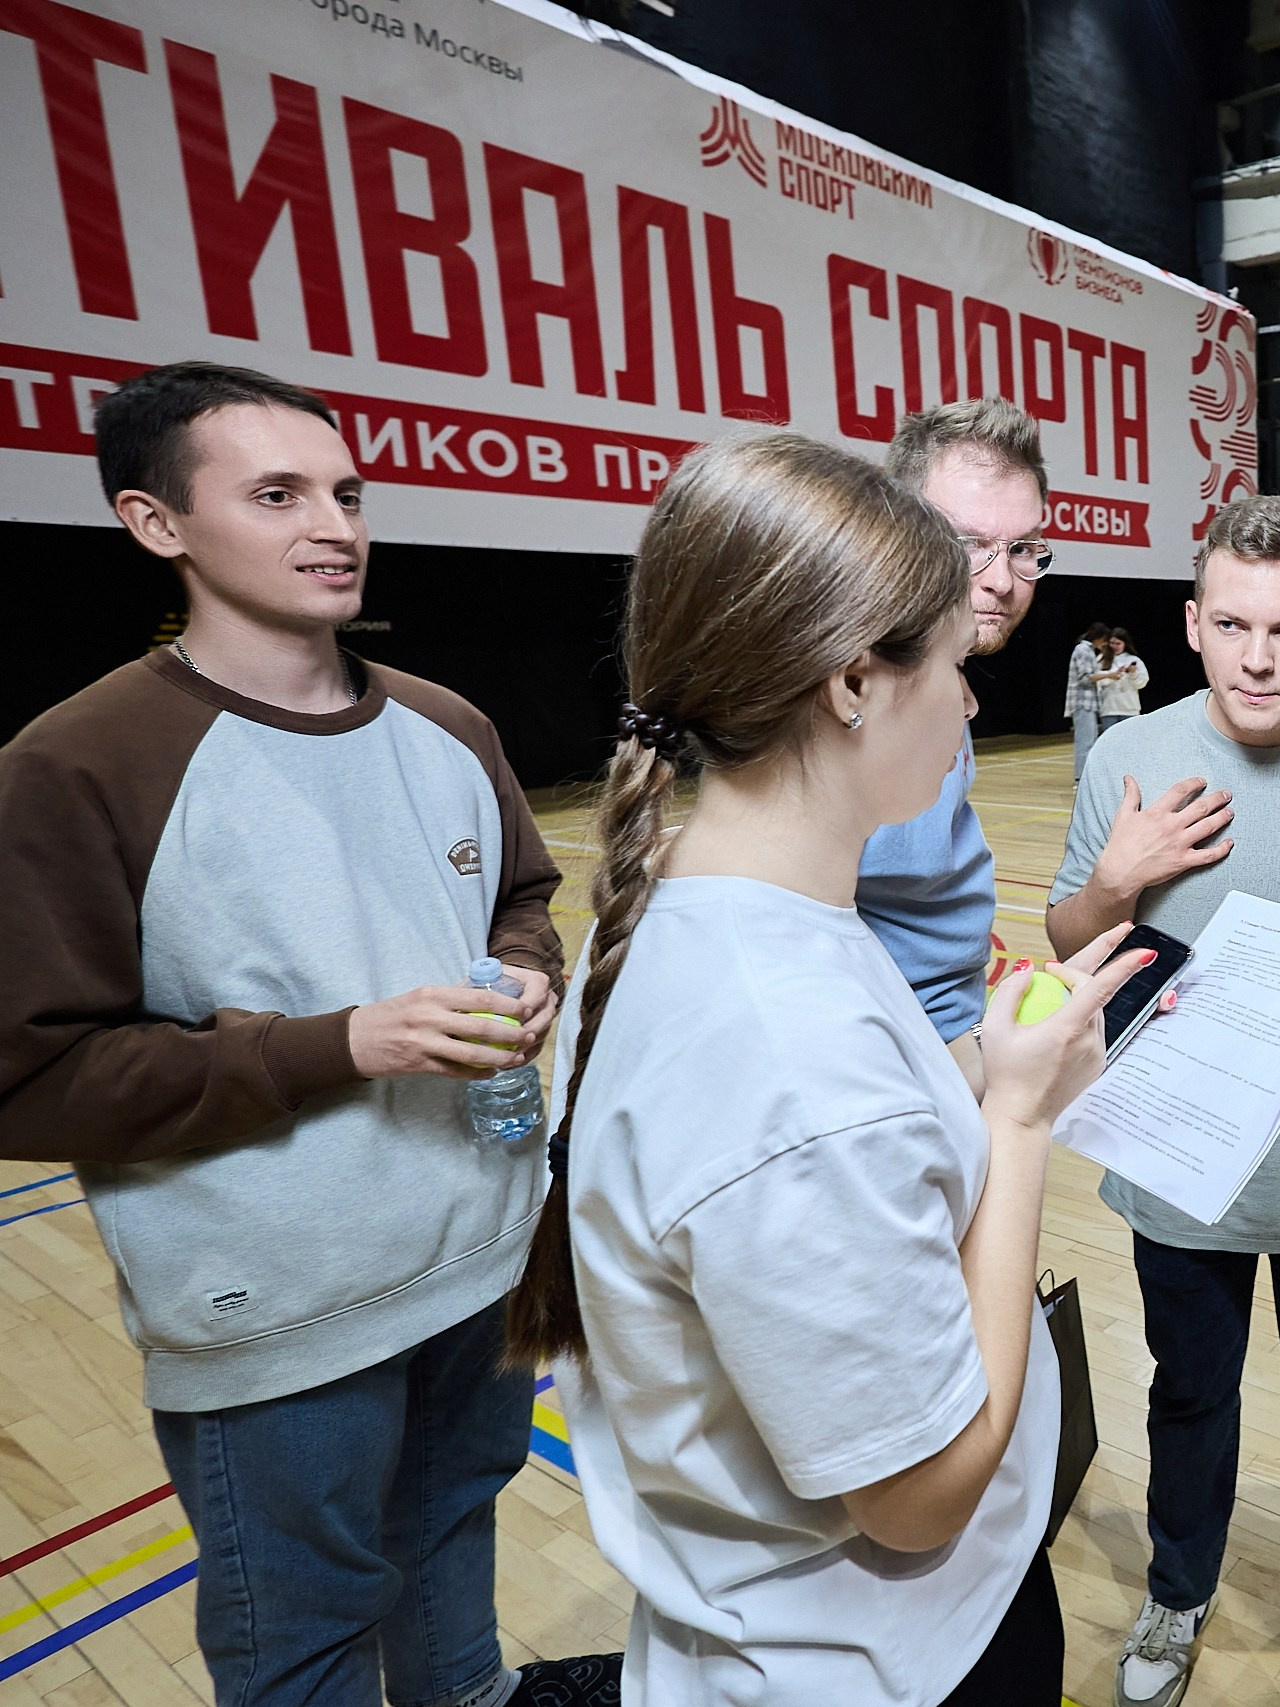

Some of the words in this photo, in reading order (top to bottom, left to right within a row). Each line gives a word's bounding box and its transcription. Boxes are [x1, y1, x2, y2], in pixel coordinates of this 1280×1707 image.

[413, 22, 523, 82] Москвы
[778, 156, 856, 219] СПОРТ
[0, 0, 791, 424] ТИВАЛЬ
[827, 253, 1149, 484] СПОРТА
[593, 443, 670, 492] ПР
[1040, 501, 1131, 537] ОСКВЫ
